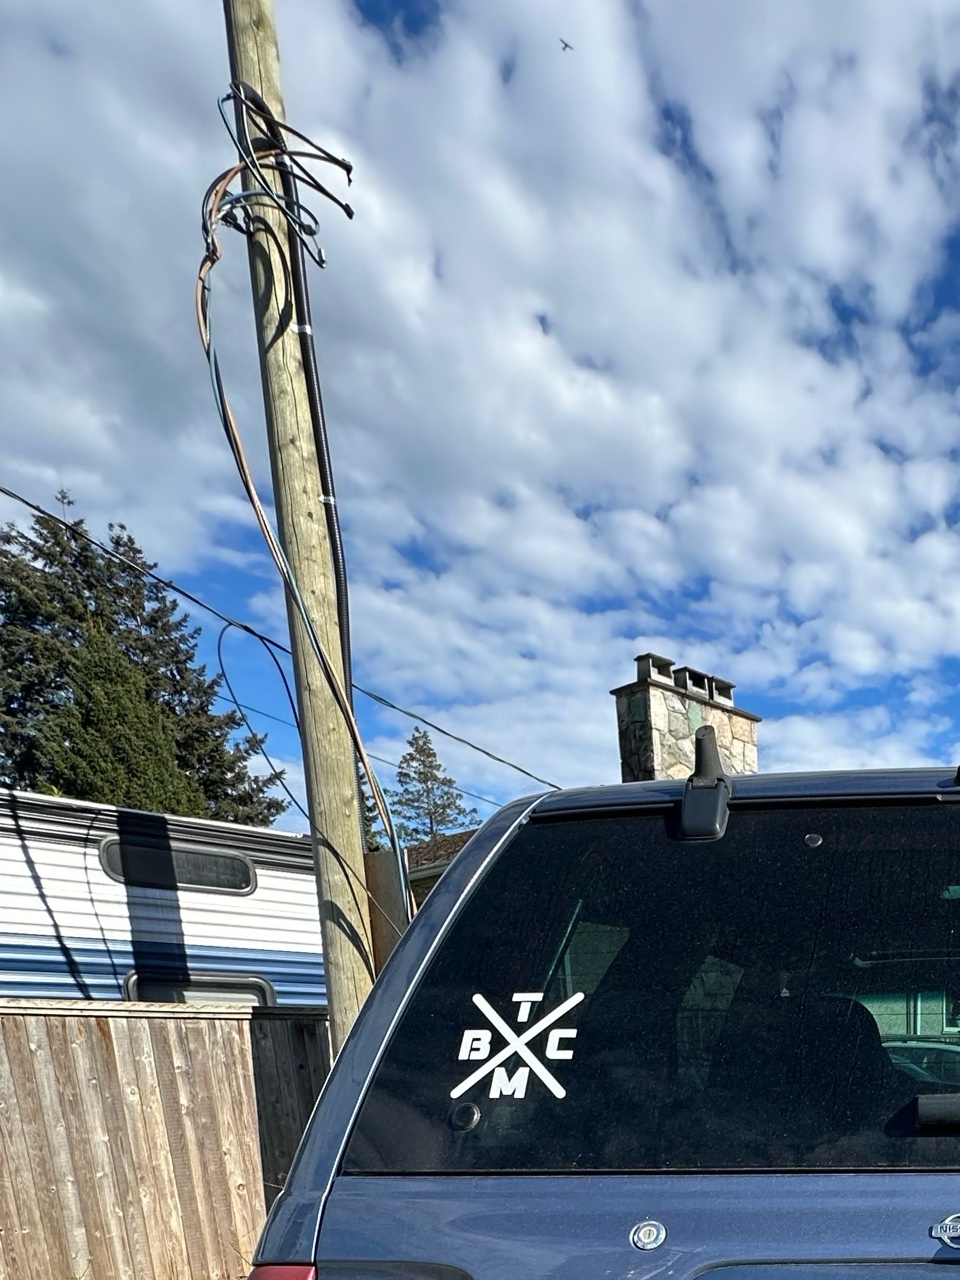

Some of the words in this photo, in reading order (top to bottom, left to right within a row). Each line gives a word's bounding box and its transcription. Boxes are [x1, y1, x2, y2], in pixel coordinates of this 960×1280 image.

[512, 992, 544, 1022] T
[458, 1029, 492, 1060] B
[545, 1028, 578, 1060] C
[488, 1066, 530, 1099] M
